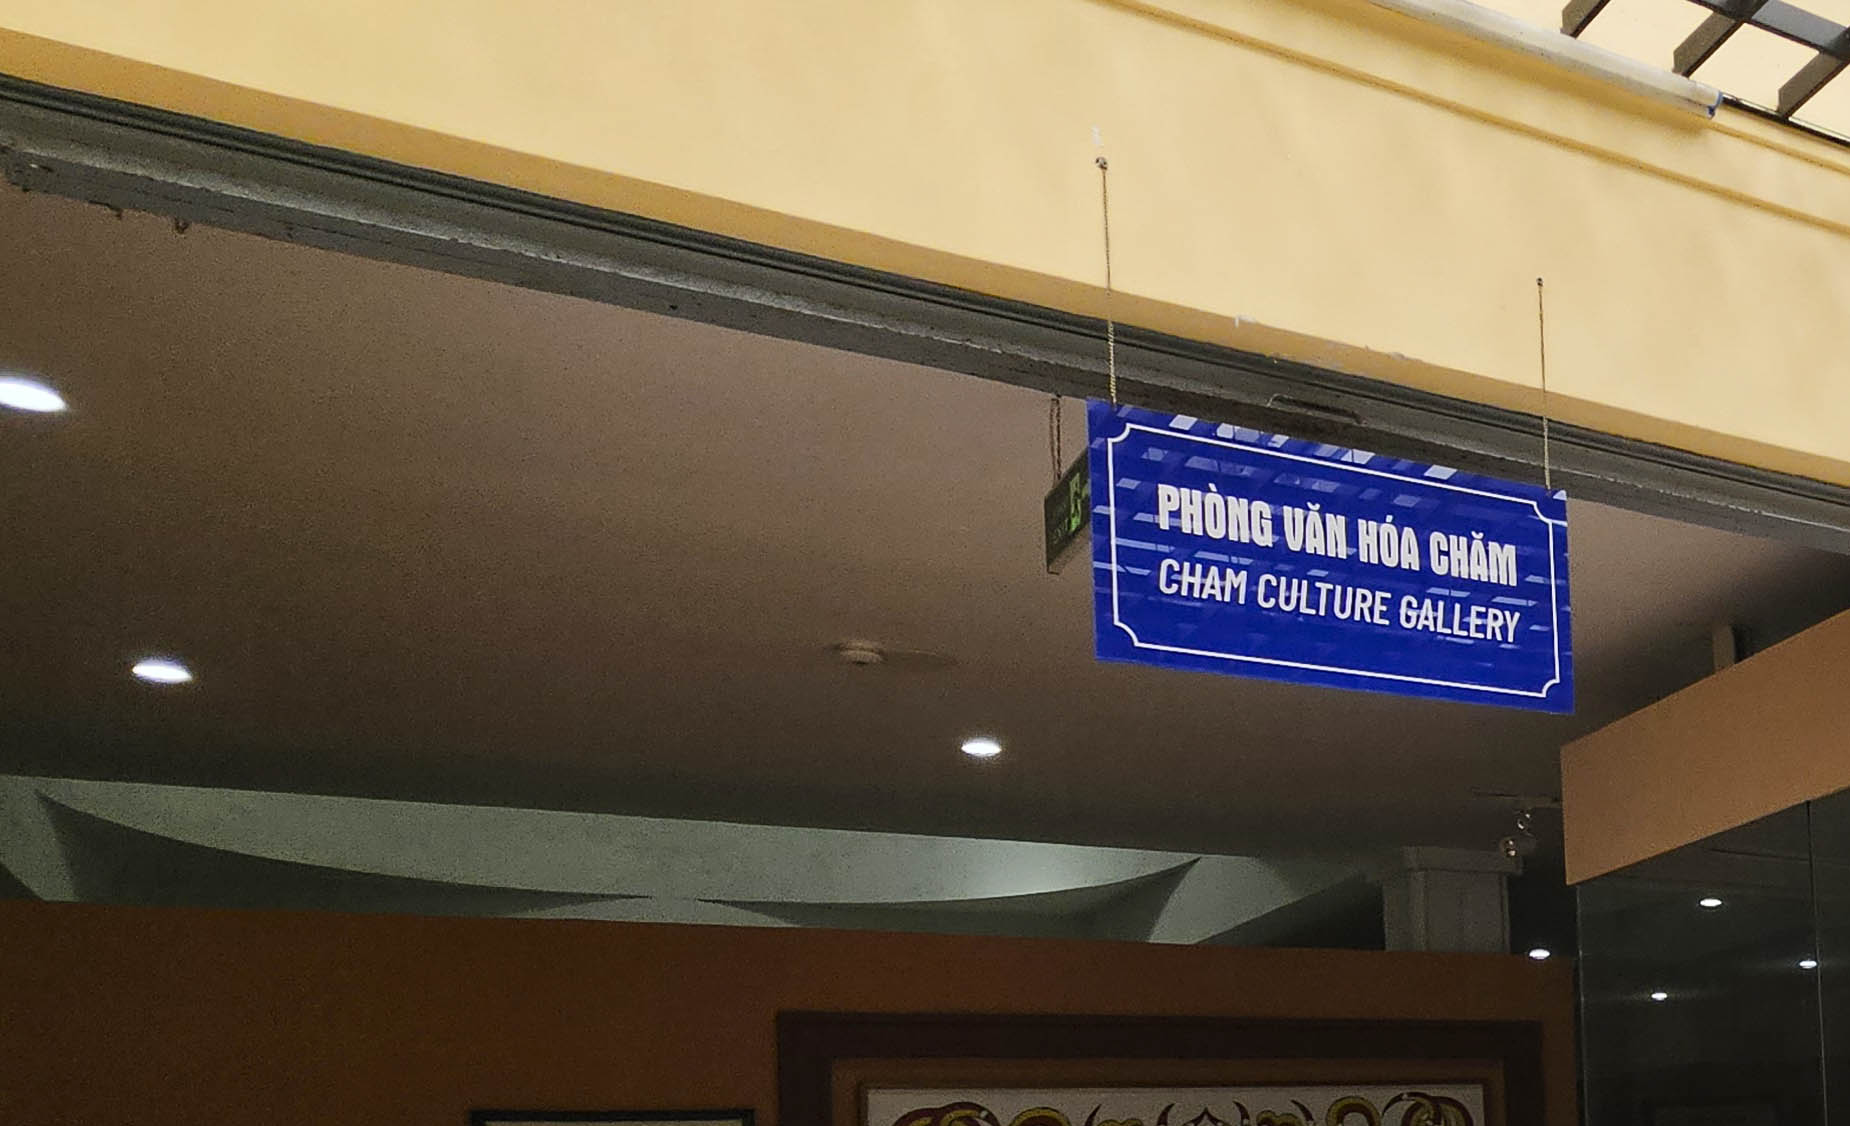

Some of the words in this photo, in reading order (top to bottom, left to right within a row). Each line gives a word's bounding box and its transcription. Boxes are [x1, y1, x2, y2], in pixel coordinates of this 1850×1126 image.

[1157, 483, 1273, 548] PHÒNG
[1284, 503, 1349, 560] VĂN
[1358, 515, 1420, 571] HÓA
[1430, 532, 1518, 587] CHĂM
[1158, 558, 1247, 605] CHAM
[1257, 574, 1390, 626] CULTURE
[1399, 595, 1521, 643] GALLERY
